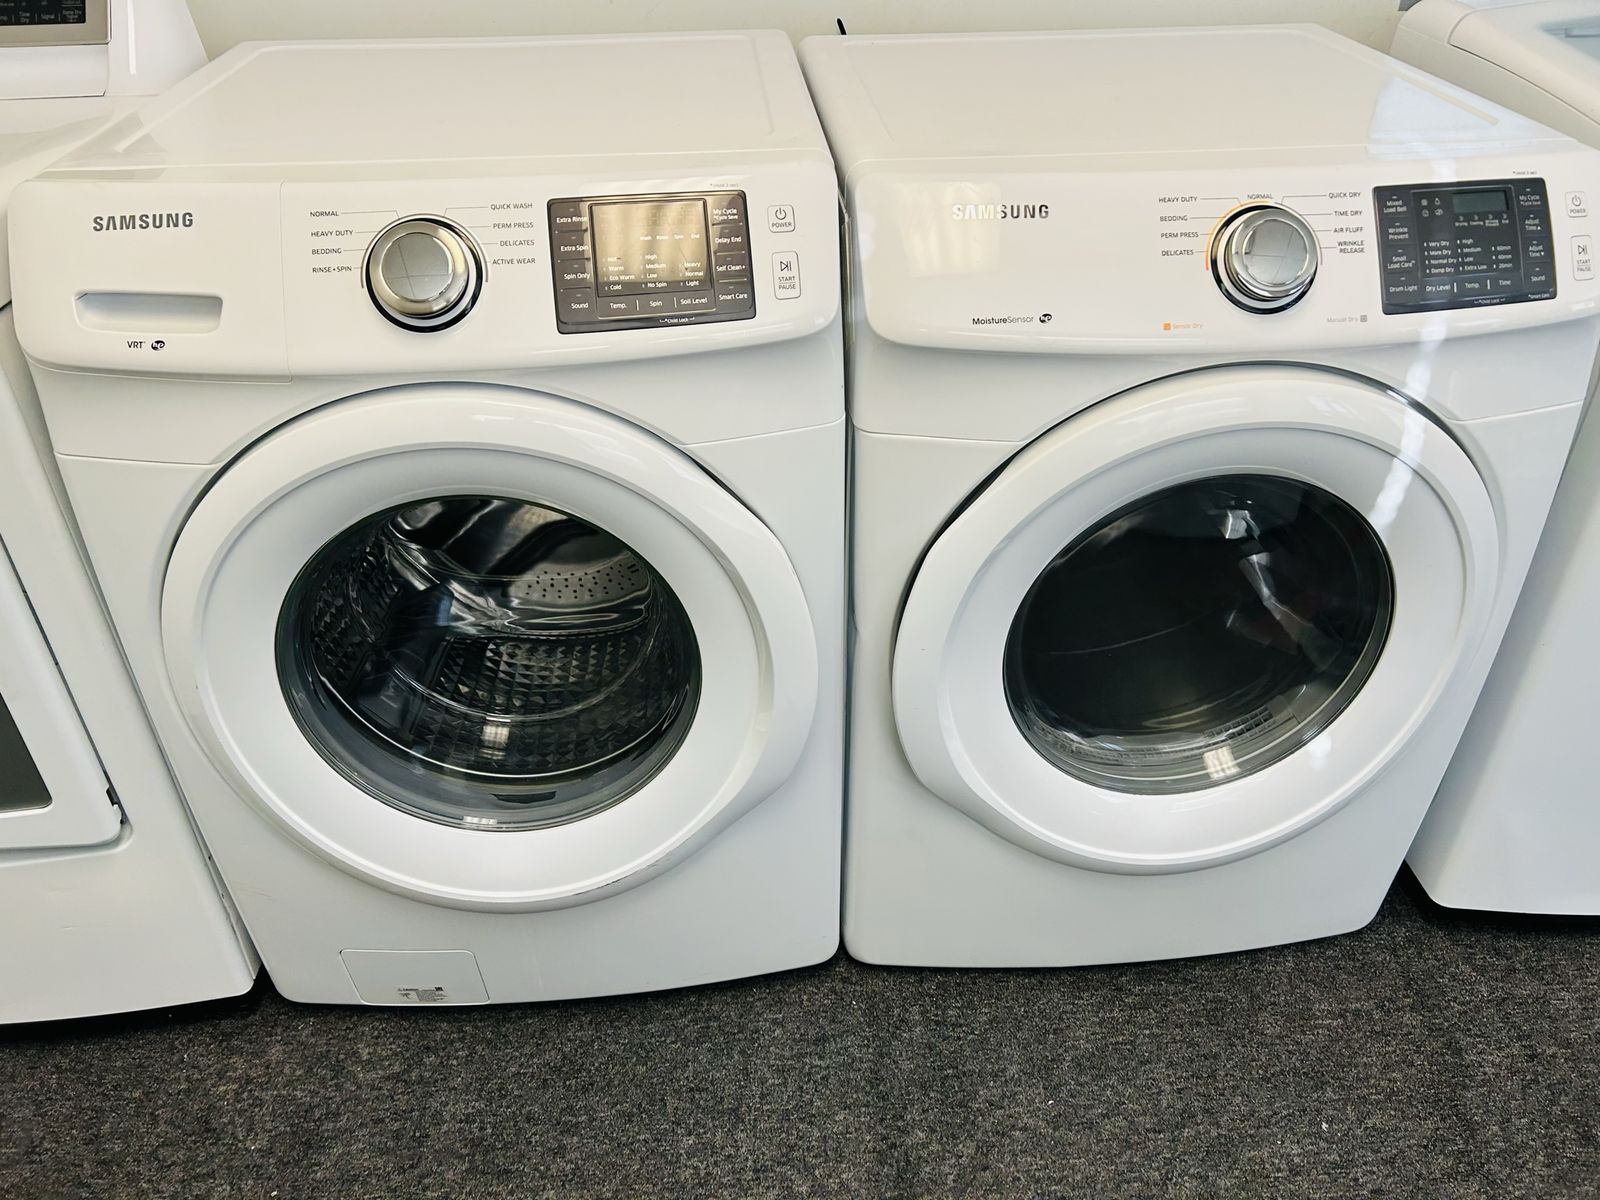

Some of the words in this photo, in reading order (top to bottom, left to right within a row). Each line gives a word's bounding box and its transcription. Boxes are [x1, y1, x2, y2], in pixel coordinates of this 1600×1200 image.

[1180, 195, 1198, 203] DUTY
[722, 207, 738, 215] Cycle
[952, 203, 1049, 220] SAMSUNG
[1349, 209, 1363, 217] DRY
[93, 212, 194, 232] SAMSUNG
[1159, 214, 1188, 222] BEDDING
[576, 244, 589, 252] Spin
[1161, 249, 1194, 257] DELICATES
[564, 273, 577, 281] Spin
[577, 271, 591, 279] Only
[692, 296, 708, 304] Level
[735, 292, 748, 300] Care
[610, 302, 627, 310] Temp.
[649, 299, 663, 307] Spin
